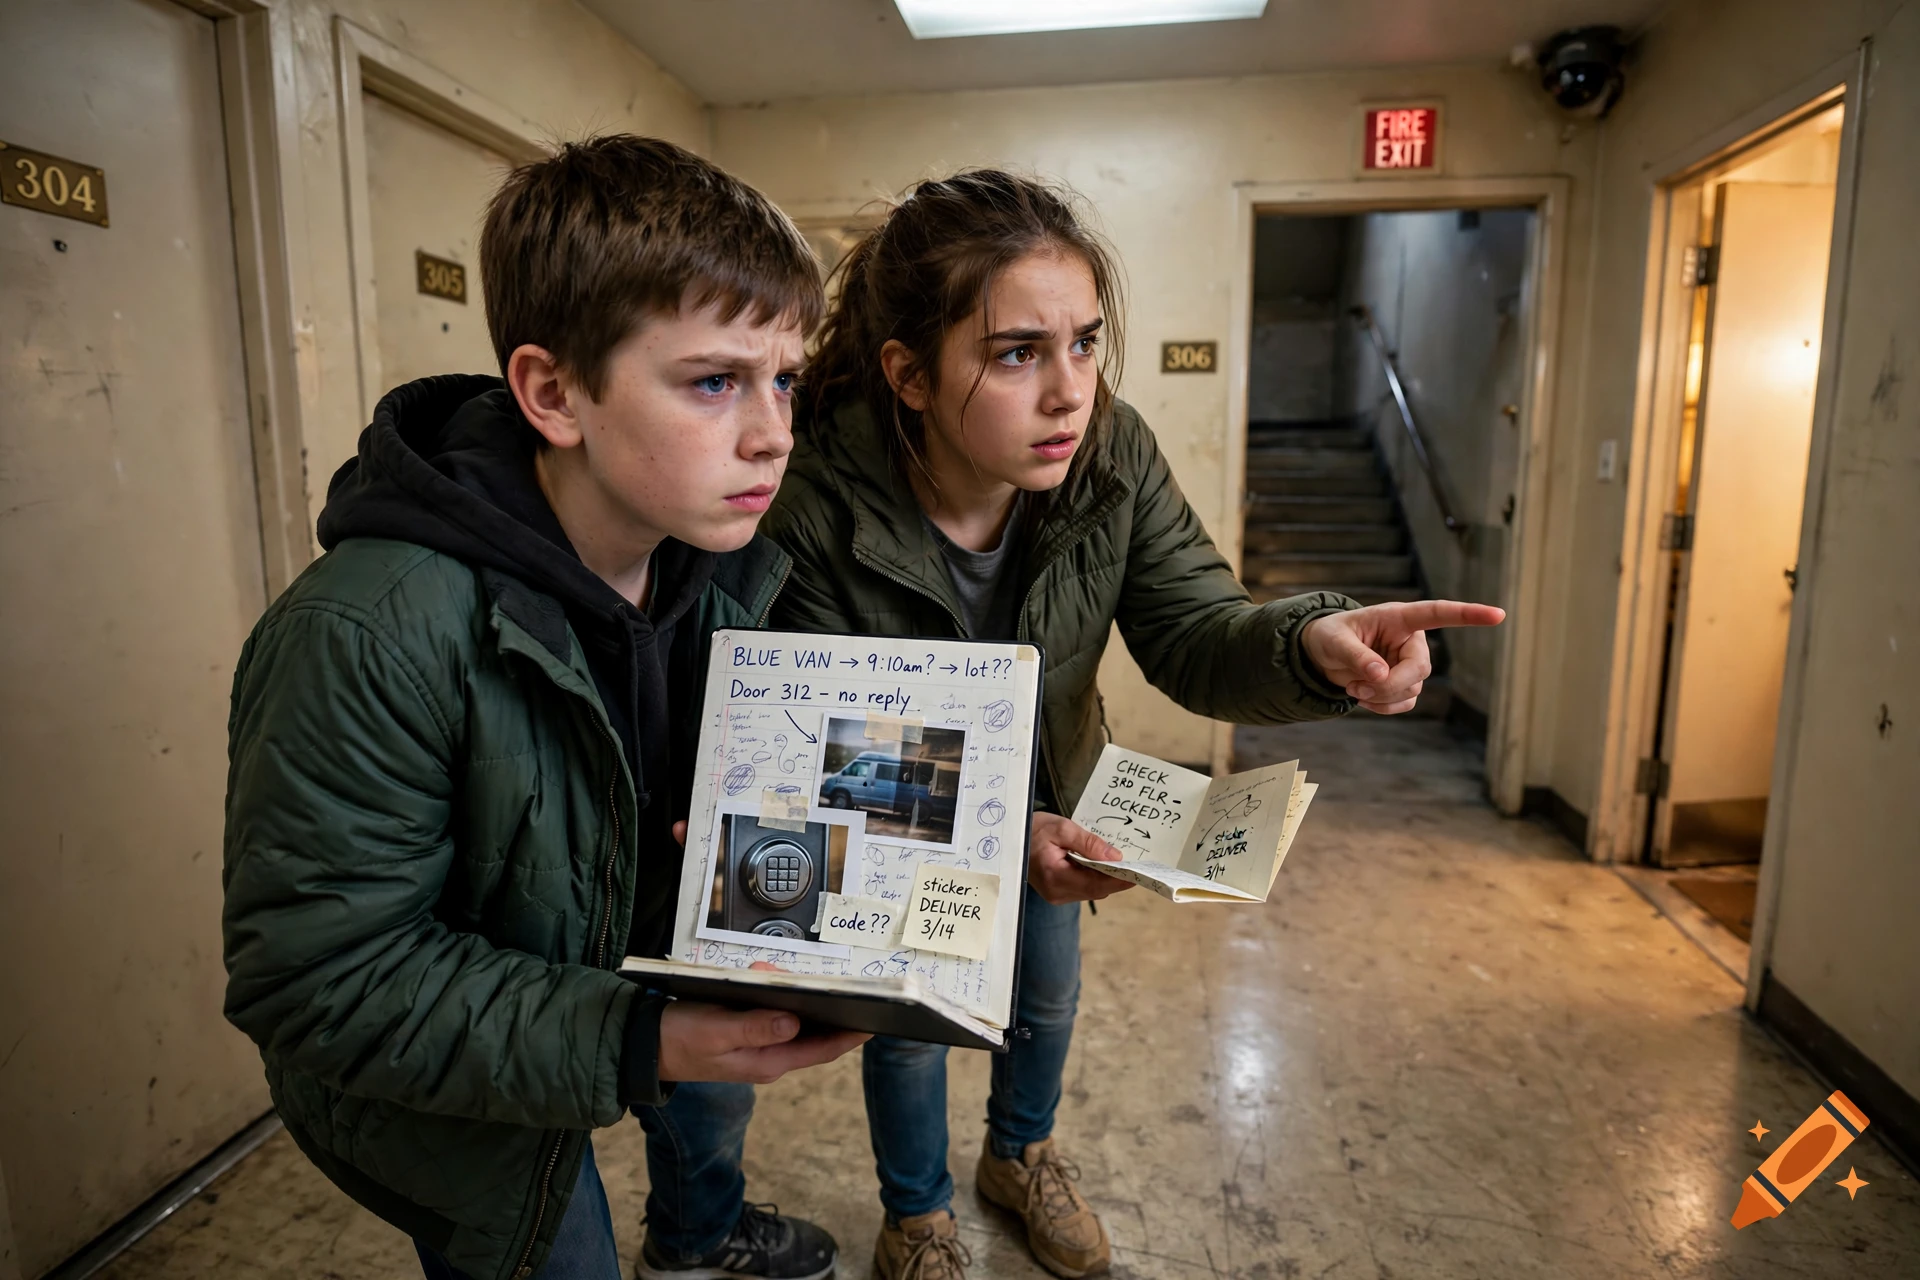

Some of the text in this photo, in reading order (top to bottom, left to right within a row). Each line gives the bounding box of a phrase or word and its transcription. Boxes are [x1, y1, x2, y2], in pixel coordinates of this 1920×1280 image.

[1375, 109, 1427, 139] FIRE
[1374, 139, 1426, 168] EXIT
[15, 158, 97, 213] 304
[423, 261, 464, 297] 305
[1166, 345, 1212, 369] 306
[732, 646, 1012, 680] BLUE VAN 9:10am? lot??
[730, 679, 771, 699] Door
[780, 683, 812, 700] 312
[838, 691, 858, 703] no
[867, 687, 911, 715] reply
[1108, 776, 1134, 789] 3RD
[1116, 760, 1169, 785] CHECK
[1101, 793, 1181, 828] LOCKED??
[1205, 841, 1248, 862] DELIVER
[1204, 863, 1226, 881] 3/14
[922, 877, 979, 897] sticker:
[919, 897, 981, 921] DELIVER
[829, 911, 891, 936] code??
[920, 917, 955, 940] 3/14
